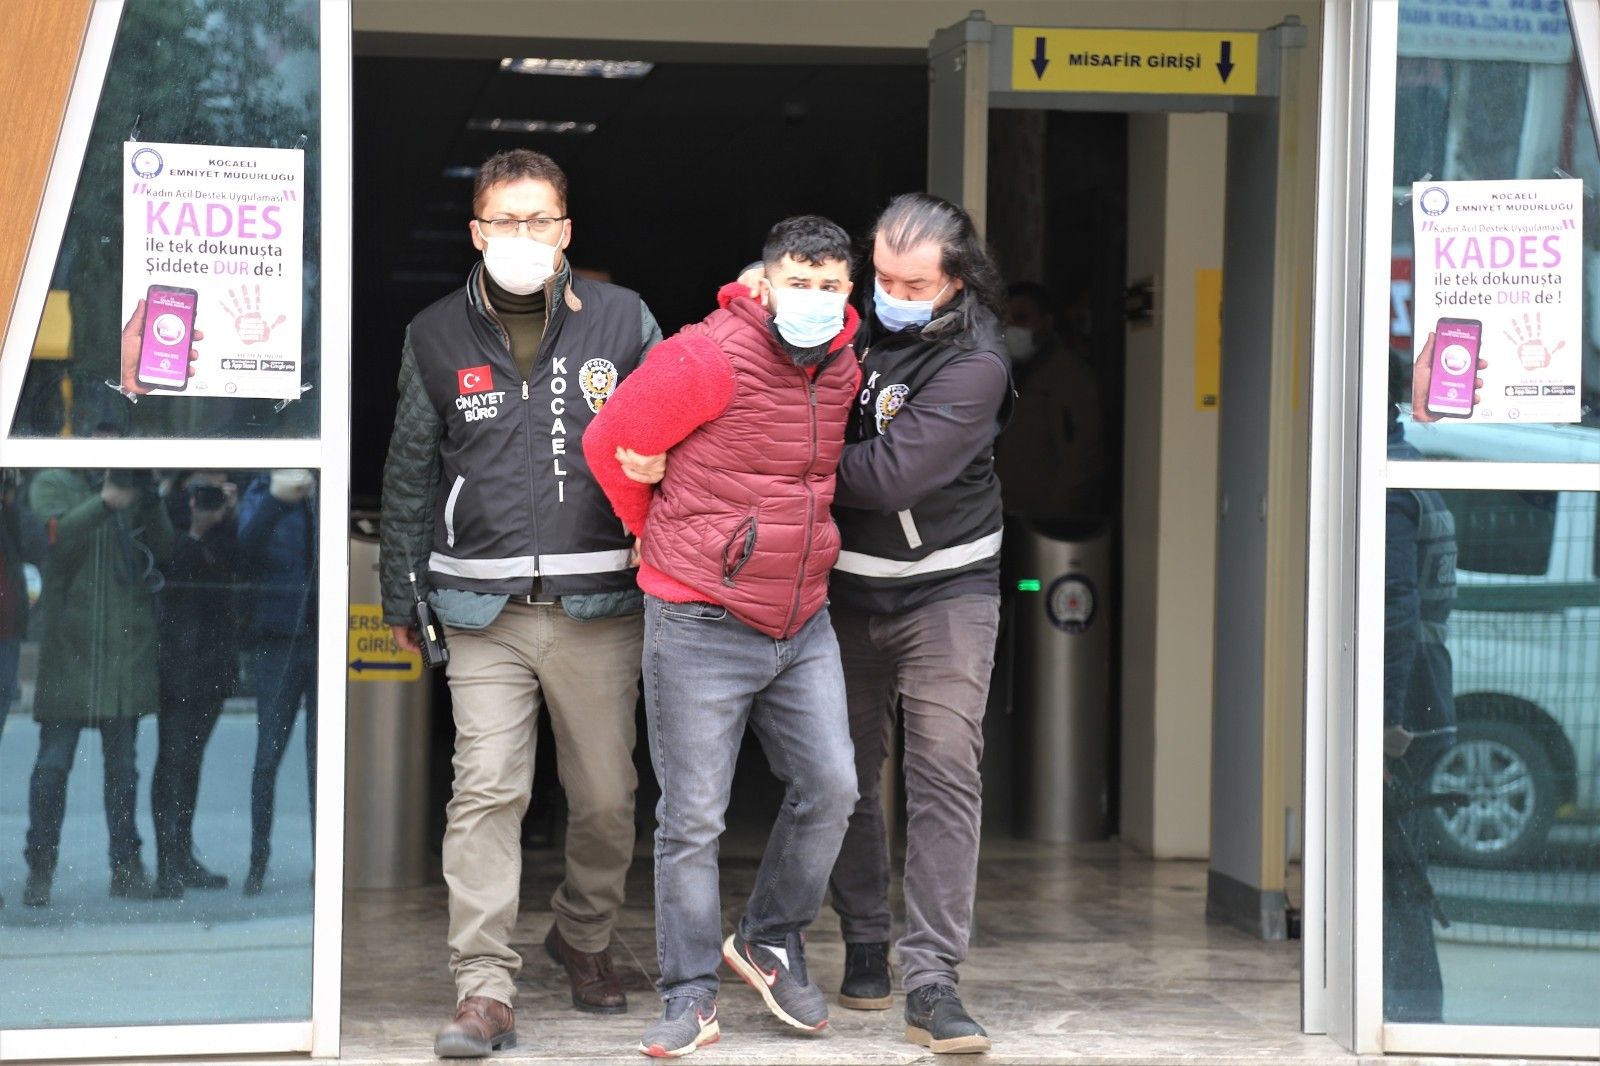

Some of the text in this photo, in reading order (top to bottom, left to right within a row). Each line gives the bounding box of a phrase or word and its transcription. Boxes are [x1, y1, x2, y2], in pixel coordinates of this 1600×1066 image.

[1069, 51, 1201, 71] MİSAFİR GİRİŞİ
[208, 159, 257, 168] KOCAELİ
[195, 190, 226, 200] Destek
[146, 200, 282, 240] KADES
[146, 237, 282, 259] ile tek dokunuşta
[1434, 235, 1562, 270] KADES
[146, 257, 209, 275] Şiddete
[213, 260, 249, 275] DUR
[253, 261, 274, 276] de
[1434, 271, 1562, 287] ile tek dokunuşta
[1434, 290, 1492, 308] Şiddete
[1497, 290, 1531, 304] DUR
[1534, 290, 1553, 304] de
